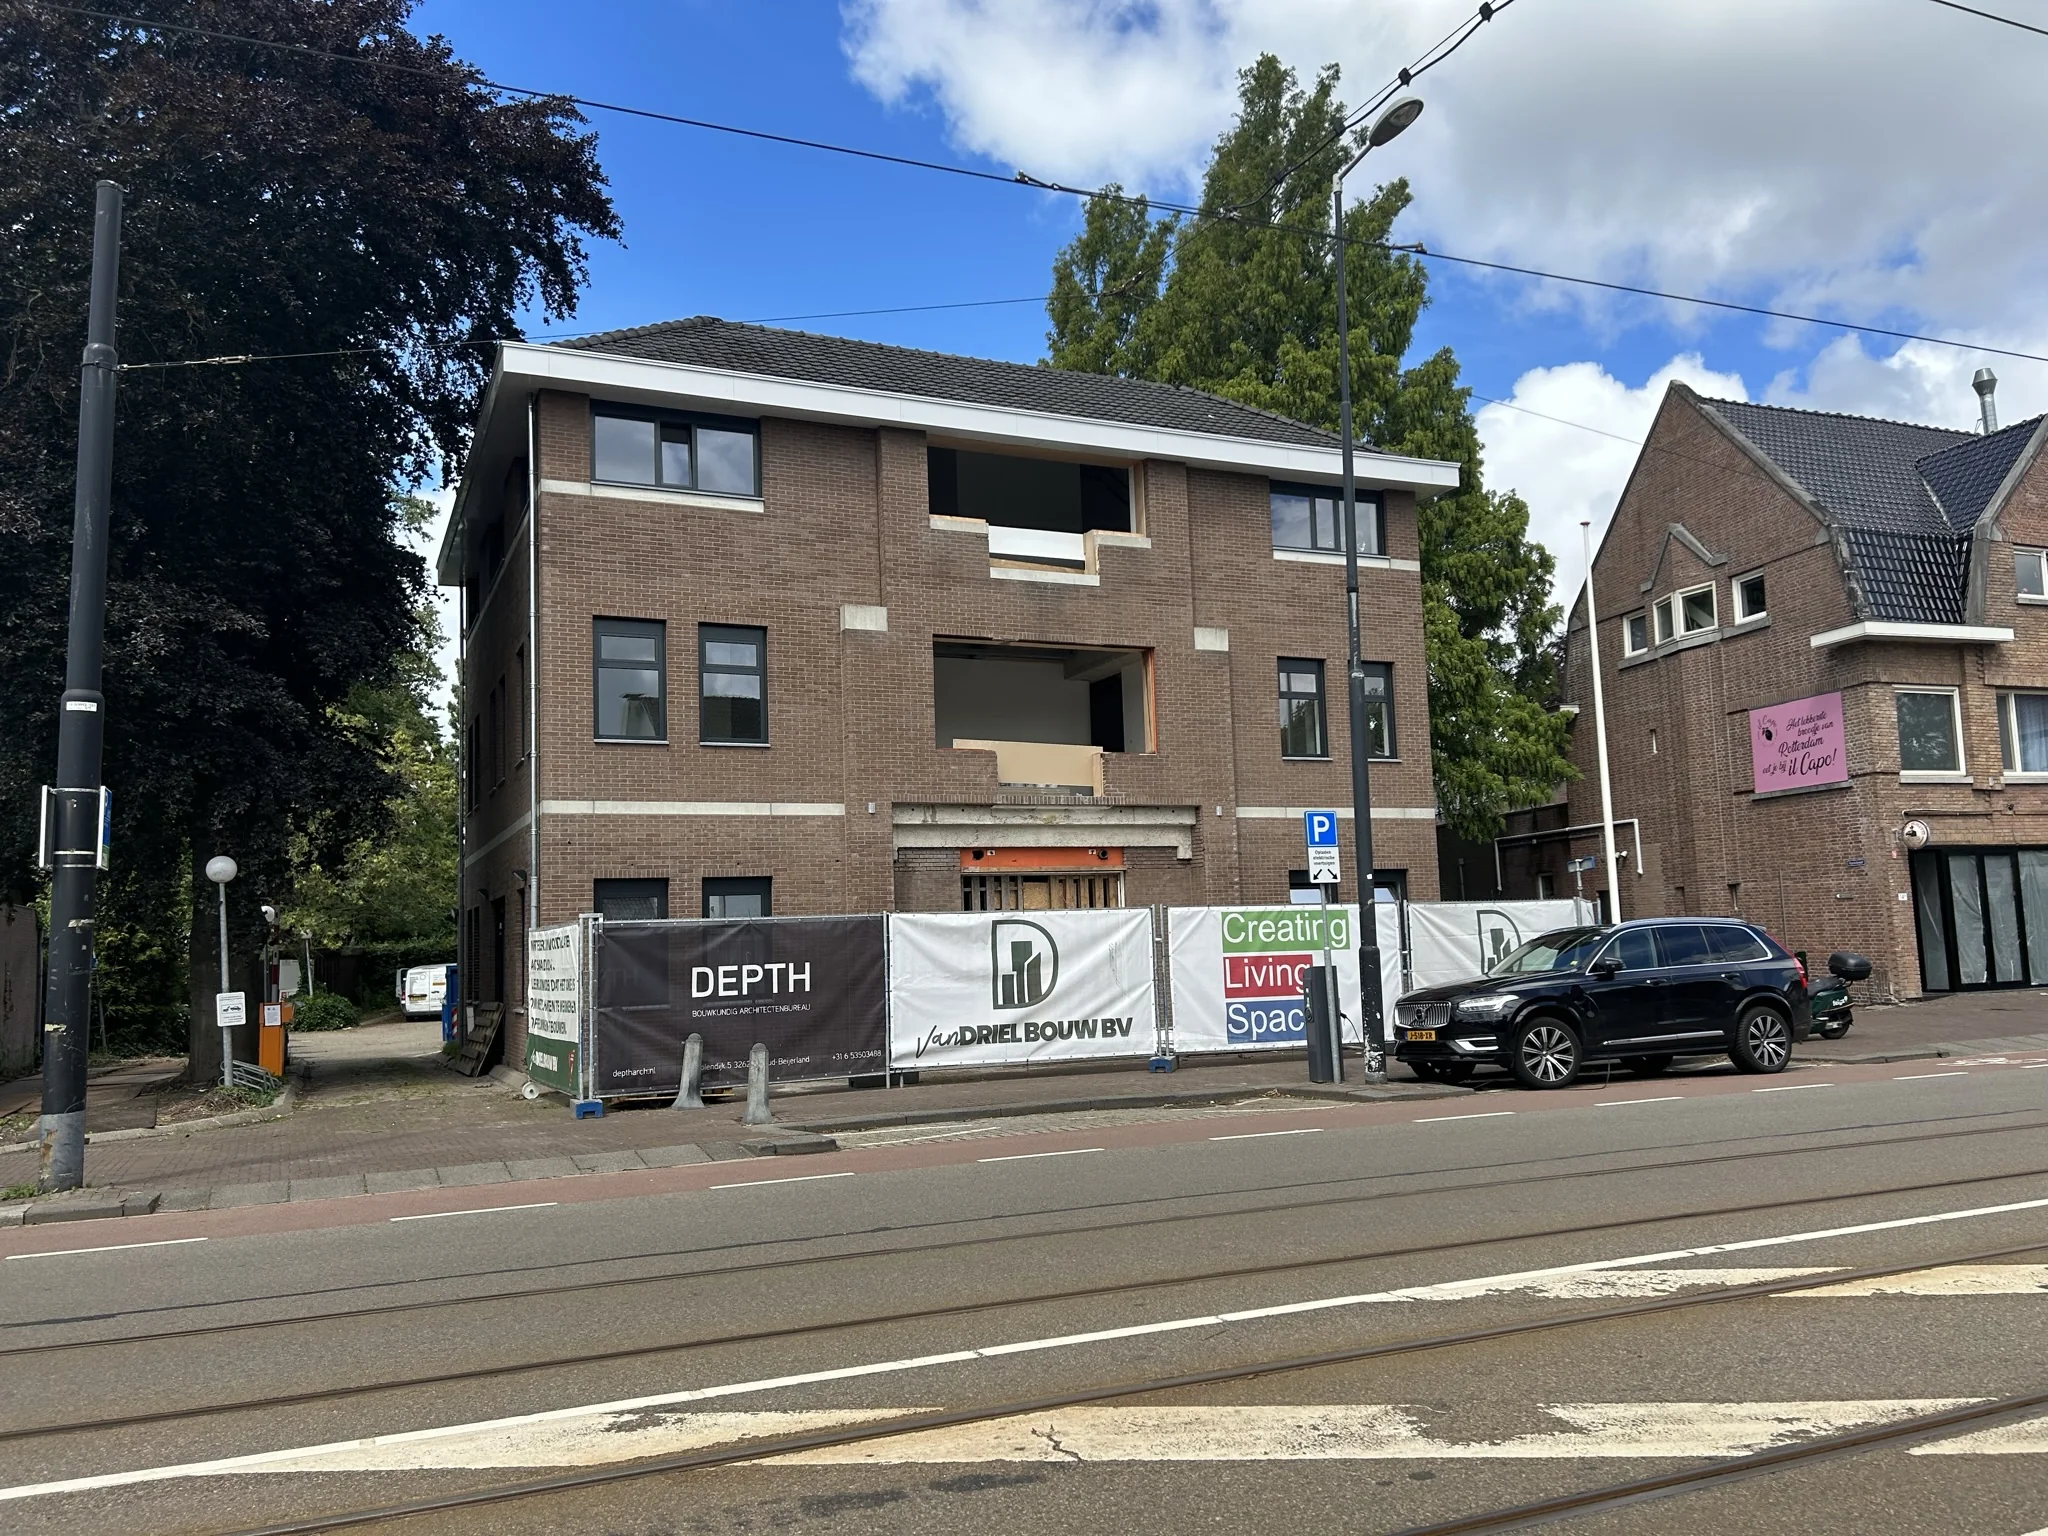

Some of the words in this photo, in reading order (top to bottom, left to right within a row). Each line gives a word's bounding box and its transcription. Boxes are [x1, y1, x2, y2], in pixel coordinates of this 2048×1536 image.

[1798, 723, 1820, 736] broodje
[1822, 722, 1834, 730] van
[1778, 736, 1824, 757] Rotterdam
[1788, 757, 1797, 776] il
[1800, 748, 1838, 776] Capo!
[1313, 816, 1330, 842] P
[1222, 912, 1347, 948] Creating
[692, 962, 810, 998] DEPTH
[1225, 958, 1310, 993] Living
[692, 1008, 738, 1018] BOUWKUNDIG
[739, 1004, 811, 1015] ARCHITECTENBUREAU
[1228, 1004, 1305, 1040] Spac
[1024, 1018, 1098, 1042] BOUW
[1102, 1016, 1134, 1038] BV
[700, 1062, 726, 1072] olendijk
[769, 1056, 810, 1066] ud-Beijerland
[832, 1052, 842, 1060] +31
